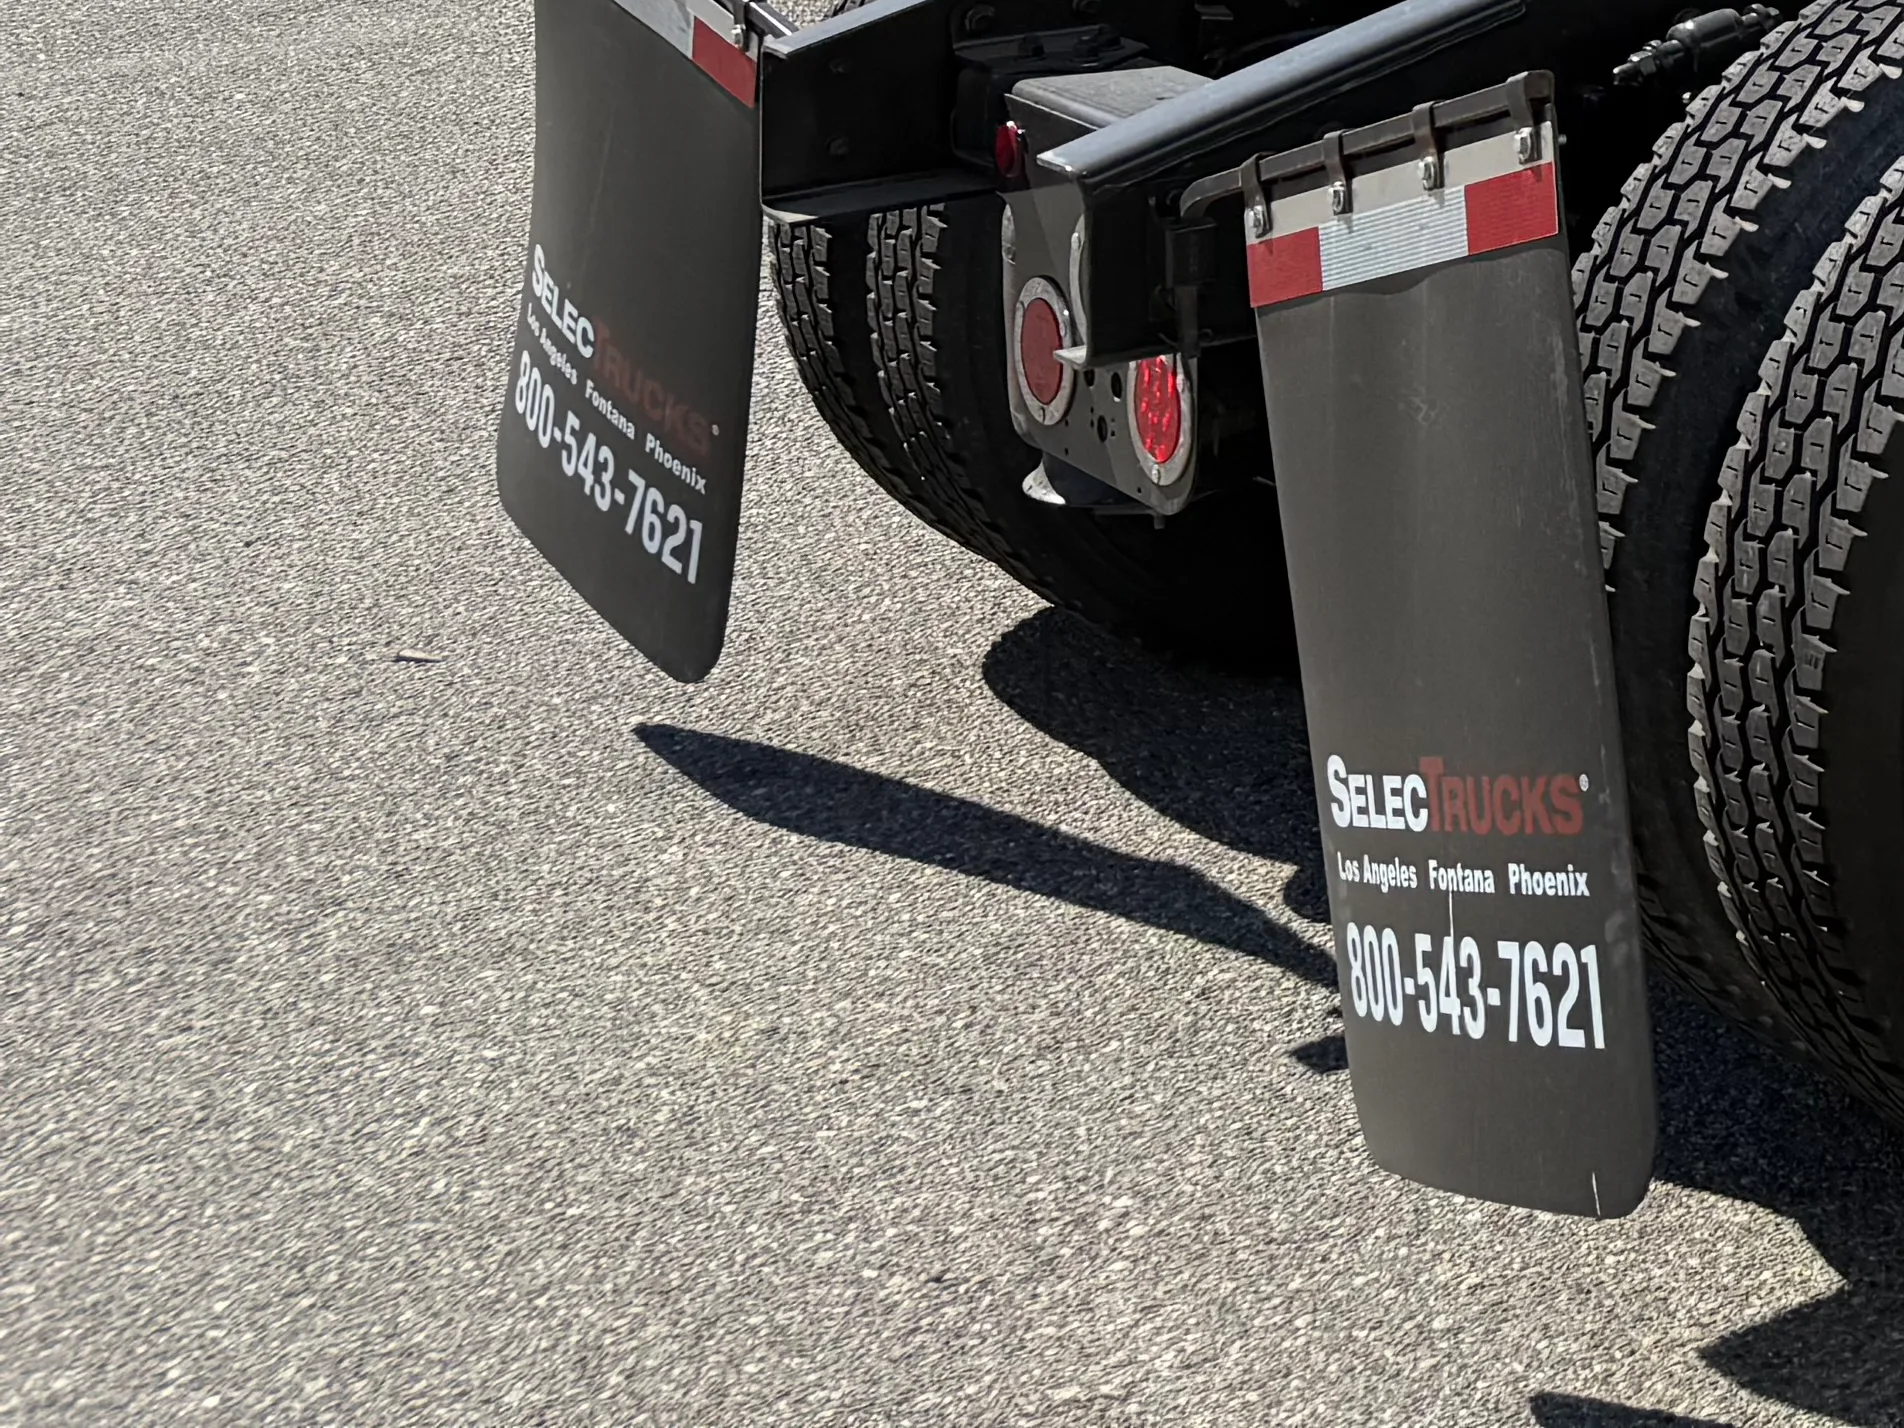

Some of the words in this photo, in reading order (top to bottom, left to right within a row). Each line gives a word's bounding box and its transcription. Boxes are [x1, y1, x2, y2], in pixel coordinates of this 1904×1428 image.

[515, 349, 703, 585] 800-543-7621
[527, 302, 540, 337] Los
[540, 327, 578, 385] Angeles
[585, 379, 635, 441] Fontana
[645, 432, 707, 495] Phoenix
[1337, 851, 1360, 883] Los
[1363, 854, 1418, 894] Angeles
[1428, 859, 1496, 894] Fontana
[1508, 862, 1590, 897] Phoenix
